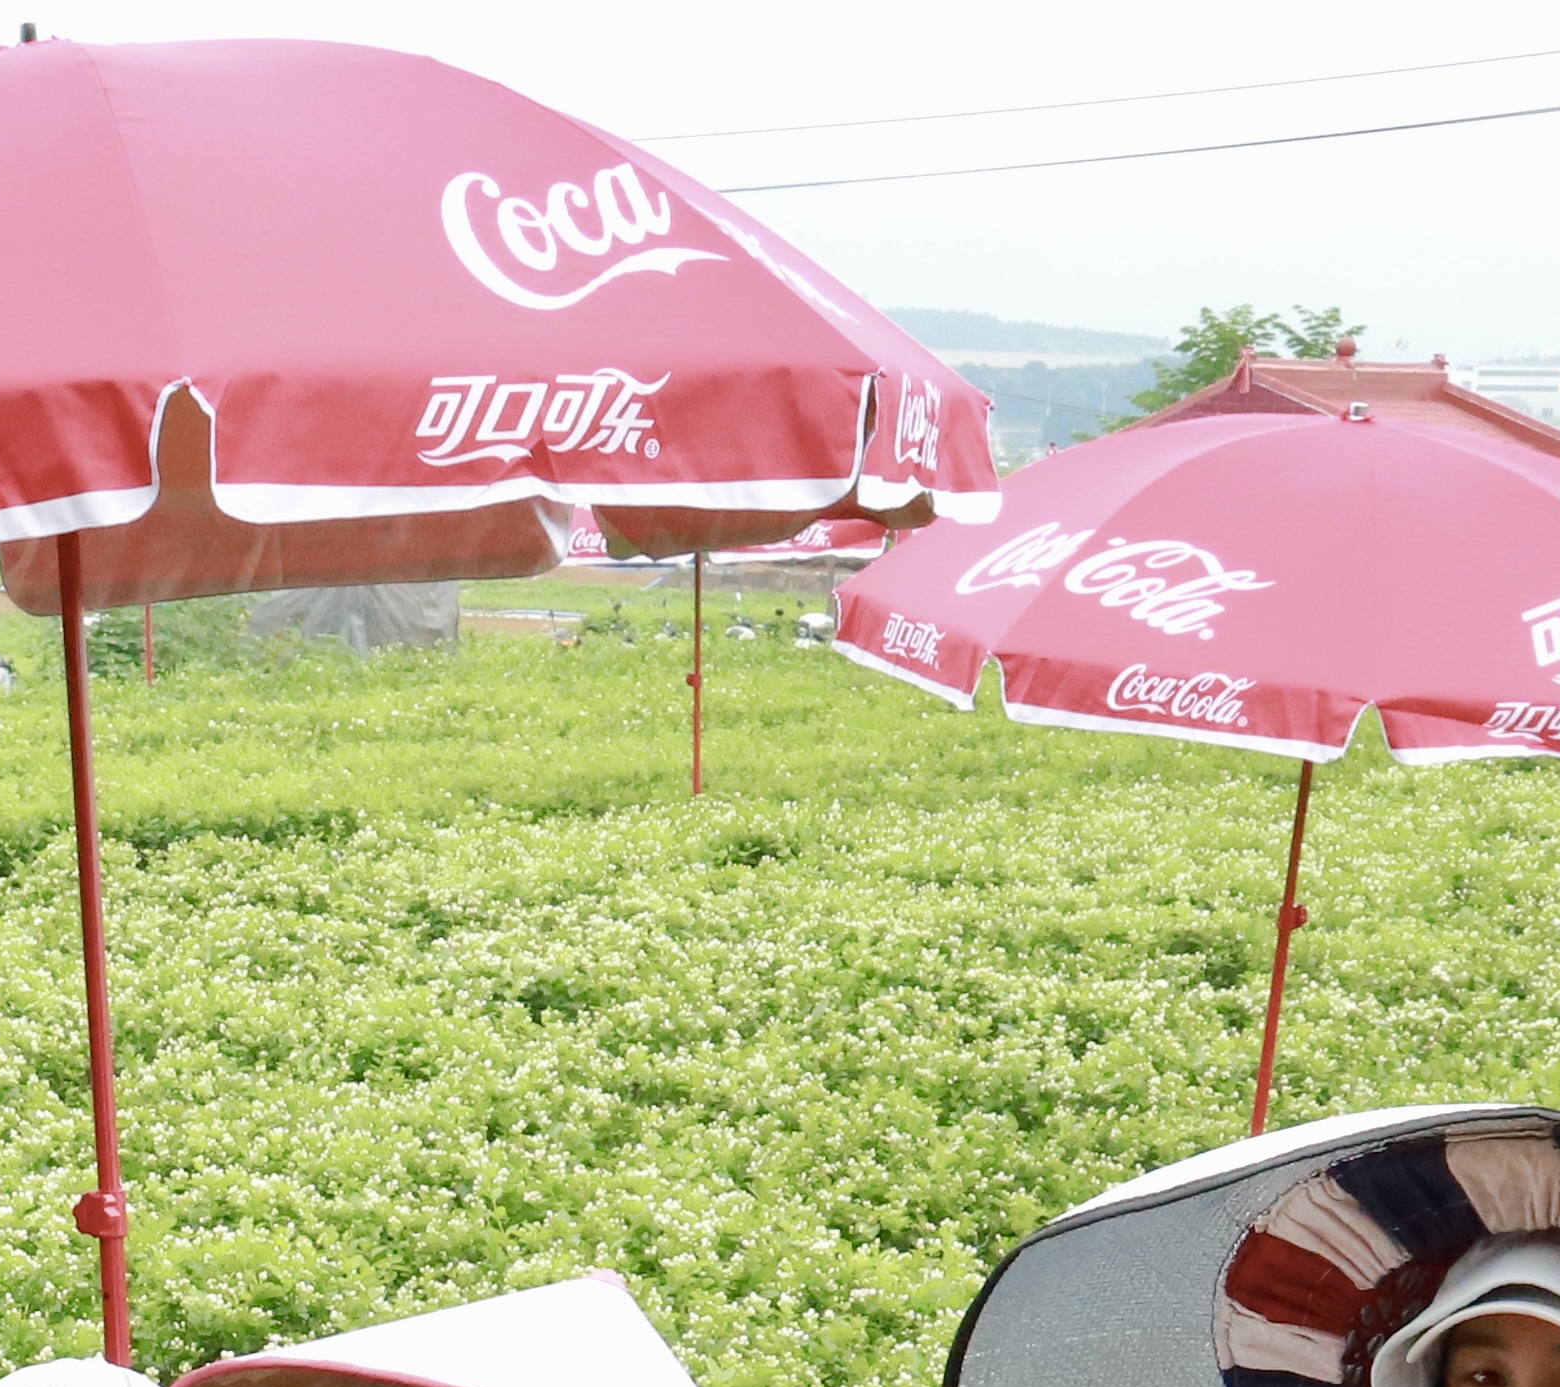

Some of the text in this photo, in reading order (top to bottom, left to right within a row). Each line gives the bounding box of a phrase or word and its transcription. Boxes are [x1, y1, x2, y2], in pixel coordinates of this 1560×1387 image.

[416, 366, 672, 467] 可口可乐
[882, 612, 946, 668] 可口可乐
[1106, 663, 1256, 725] Coca-Cola
